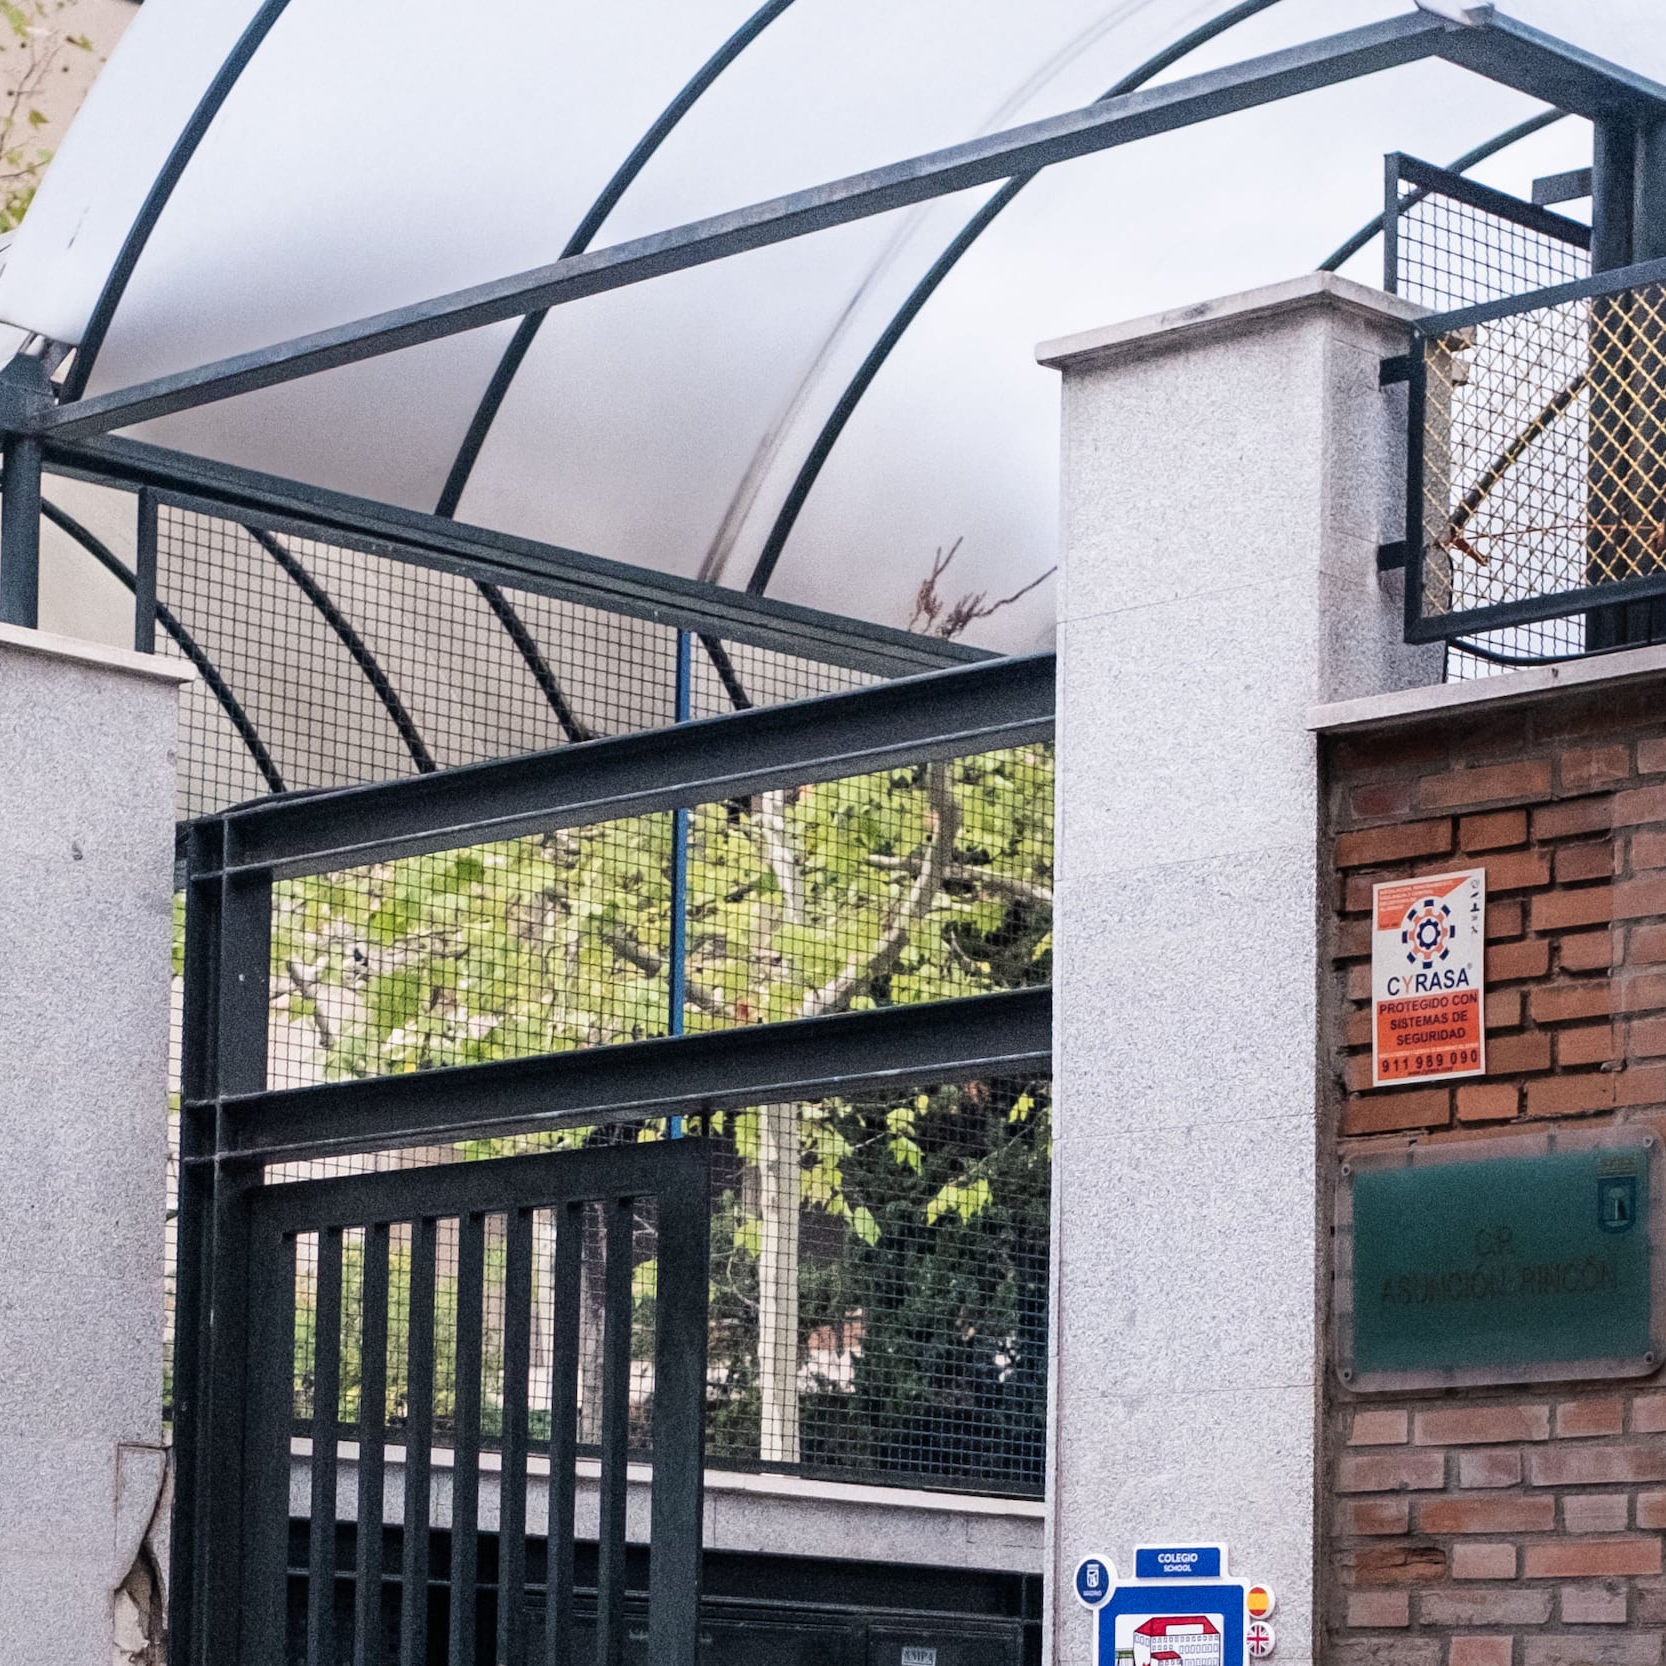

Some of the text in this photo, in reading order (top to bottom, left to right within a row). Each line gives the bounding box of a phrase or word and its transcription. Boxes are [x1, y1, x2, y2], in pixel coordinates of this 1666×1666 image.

[1379, 992, 1478, 1015] PROTEGIDO CON
[1390, 1010, 1468, 1031] SISTEMAS DE
[1396, 1027, 1466, 1046] SEGURIDAD
[1382, 1056, 1409, 1073] 911
[1415, 1052, 1443, 1069] 989
[1451, 1049, 1478, 1065] 090
[1157, 1552, 1198, 1564] COLEGIO
[1163, 1564, 1192, 1573] SCHOOL
